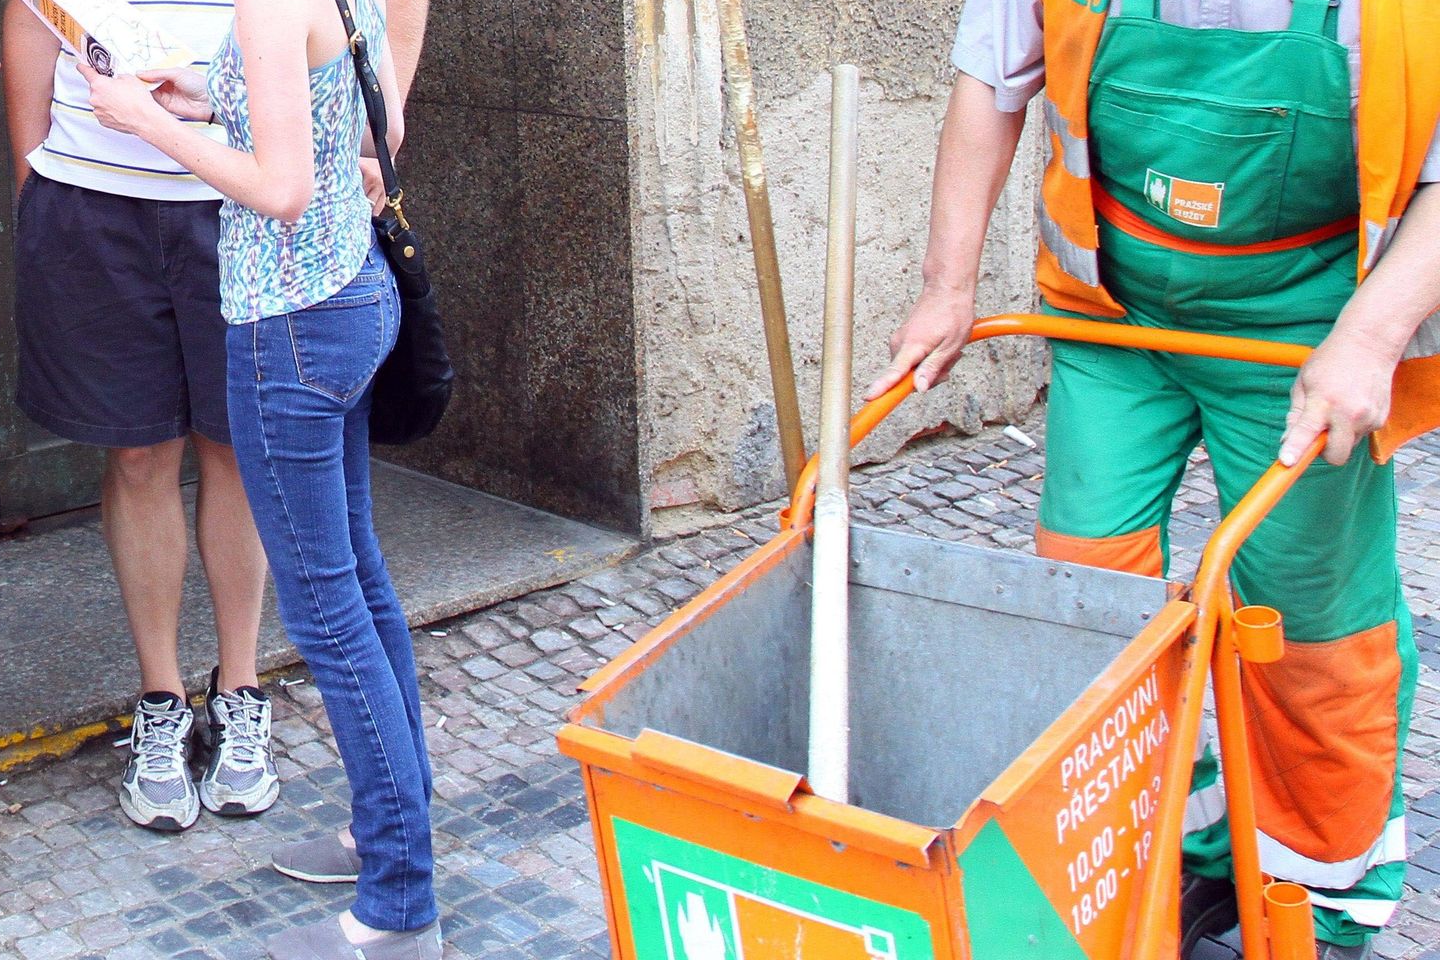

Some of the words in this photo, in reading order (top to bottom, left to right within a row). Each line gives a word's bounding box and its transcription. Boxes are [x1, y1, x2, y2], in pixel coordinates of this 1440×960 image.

[1056, 709, 1170, 844] PŘESTÁVKA
[1060, 665, 1159, 792] PRACOVNÍ
[1067, 825, 1114, 893] 10.00
[1071, 867, 1117, 936] 18.00
